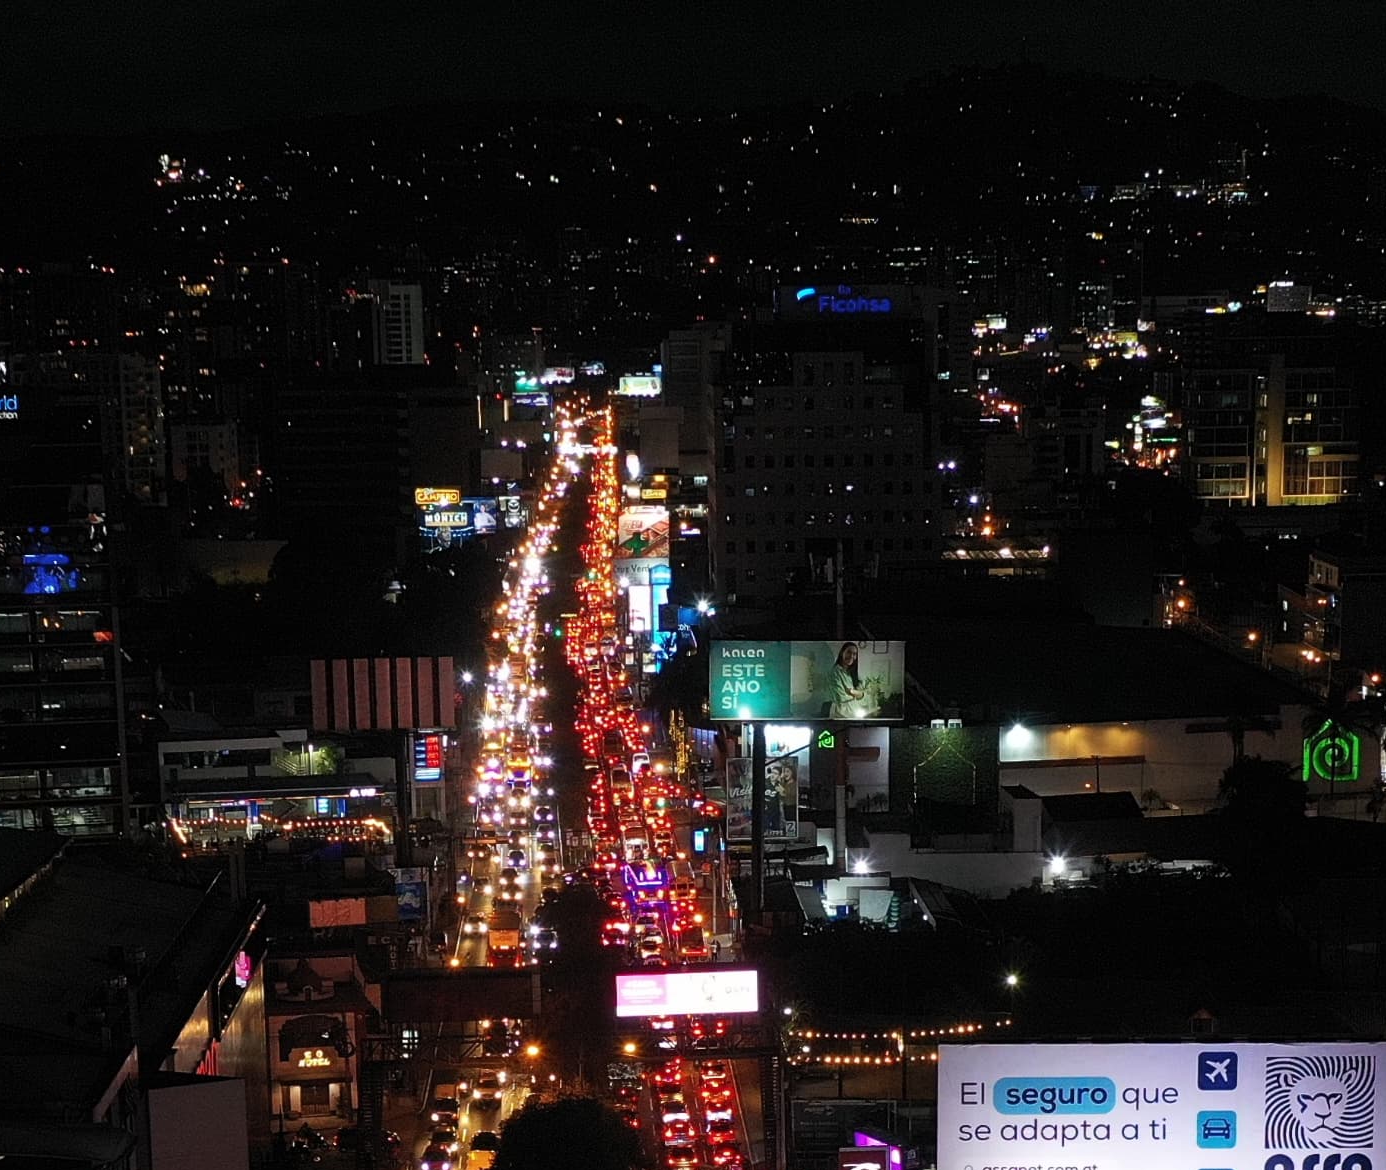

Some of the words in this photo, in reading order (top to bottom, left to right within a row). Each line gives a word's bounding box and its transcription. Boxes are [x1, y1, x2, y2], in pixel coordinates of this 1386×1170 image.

[819, 295, 891, 313] Ficohsa
[721, 664, 765, 677] ESTE
[721, 677, 760, 693] AÑO
[721, 693, 739, 710] SÍ
[960, 1082, 985, 1105] El
[1005, 1086, 1108, 1114] seguro
[1121, 1086, 1179, 1111] que
[958, 1123, 992, 1141] se
[999, 1118, 1111, 1147] adapta
[1120, 1123, 1139, 1141] a
[1148, 1117, 1167, 1141] ti
